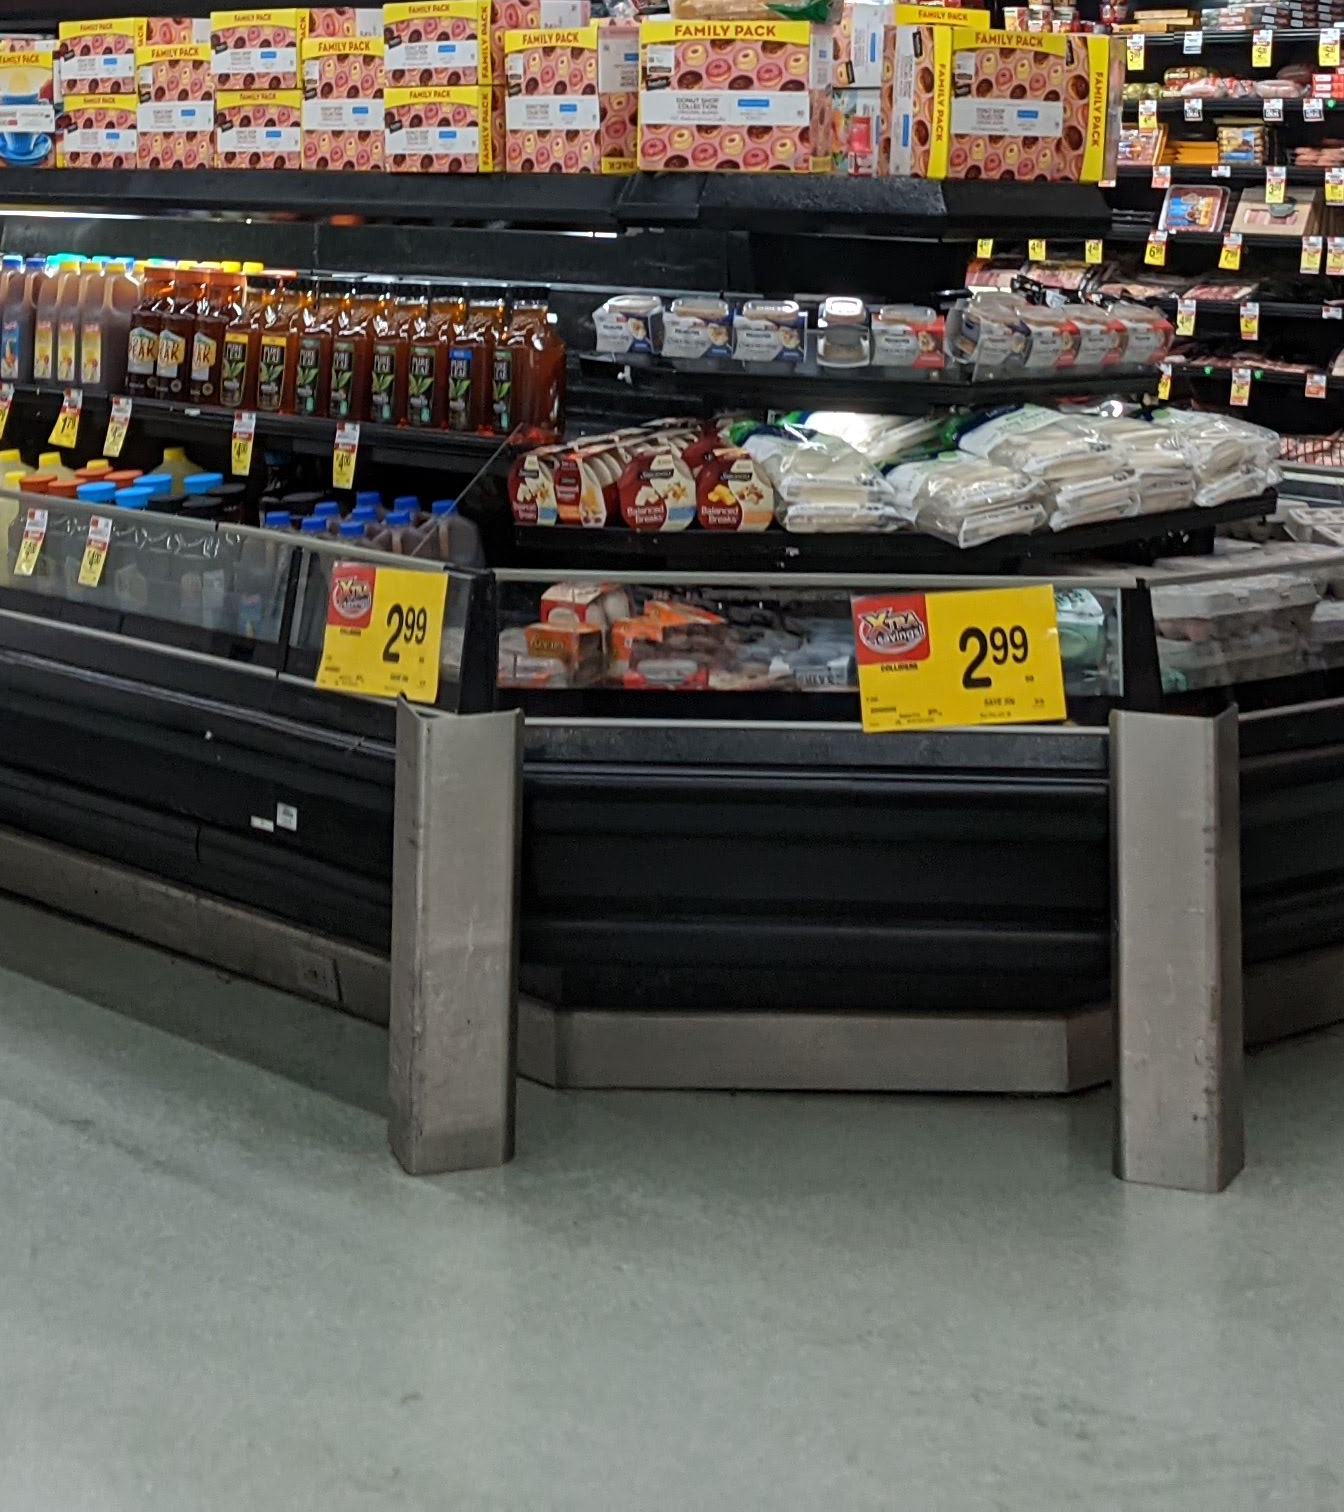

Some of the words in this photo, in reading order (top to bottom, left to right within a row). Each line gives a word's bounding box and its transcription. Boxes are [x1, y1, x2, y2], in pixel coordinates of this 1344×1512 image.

[234, 14, 253, 22] FAMILY
[254, 13, 272, 21] PACK
[408, 6, 430, 14] FAMILY
[432, 4, 450, 13] PACK
[918, 10, 946, 20] FAMILY
[947, 12, 968, 21] PACK
[481, 5, 489, 37] PACK
[674, 24, 731, 37] FAMILY
[734, 24, 777, 37] PACK
[318, 42, 346, 52] FAMILY
[348, 40, 371, 51] PACK
[522, 34, 552, 44] FAMILY
[554, 31, 580, 44] PACK
[975, 32, 1015, 46] FAMILY
[1016, 36, 1043, 48] PACK
[0, 55, 20, 65] FAMILY
[22, 54, 40, 64] PACK
[151, 48, 177, 59] FAMILY
[179, 47, 200, 57] PACK
[481, 40, 489, 79] FAMILY
[409, 90, 430, 99] FAMILY
[432, 90, 451, 99] PACK
[936, 63, 946, 107] FAMILY
[1092, 71, 1104, 116] FAMILY
[481, 91, 489, 122] PACK
[936, 110, 946, 142] PACK
[1092, 118, 1104, 147] PACK
[481, 124, 489, 166] FAMILY
[382, 603, 427, 663] 299
[959, 625, 1029, 690] 299
